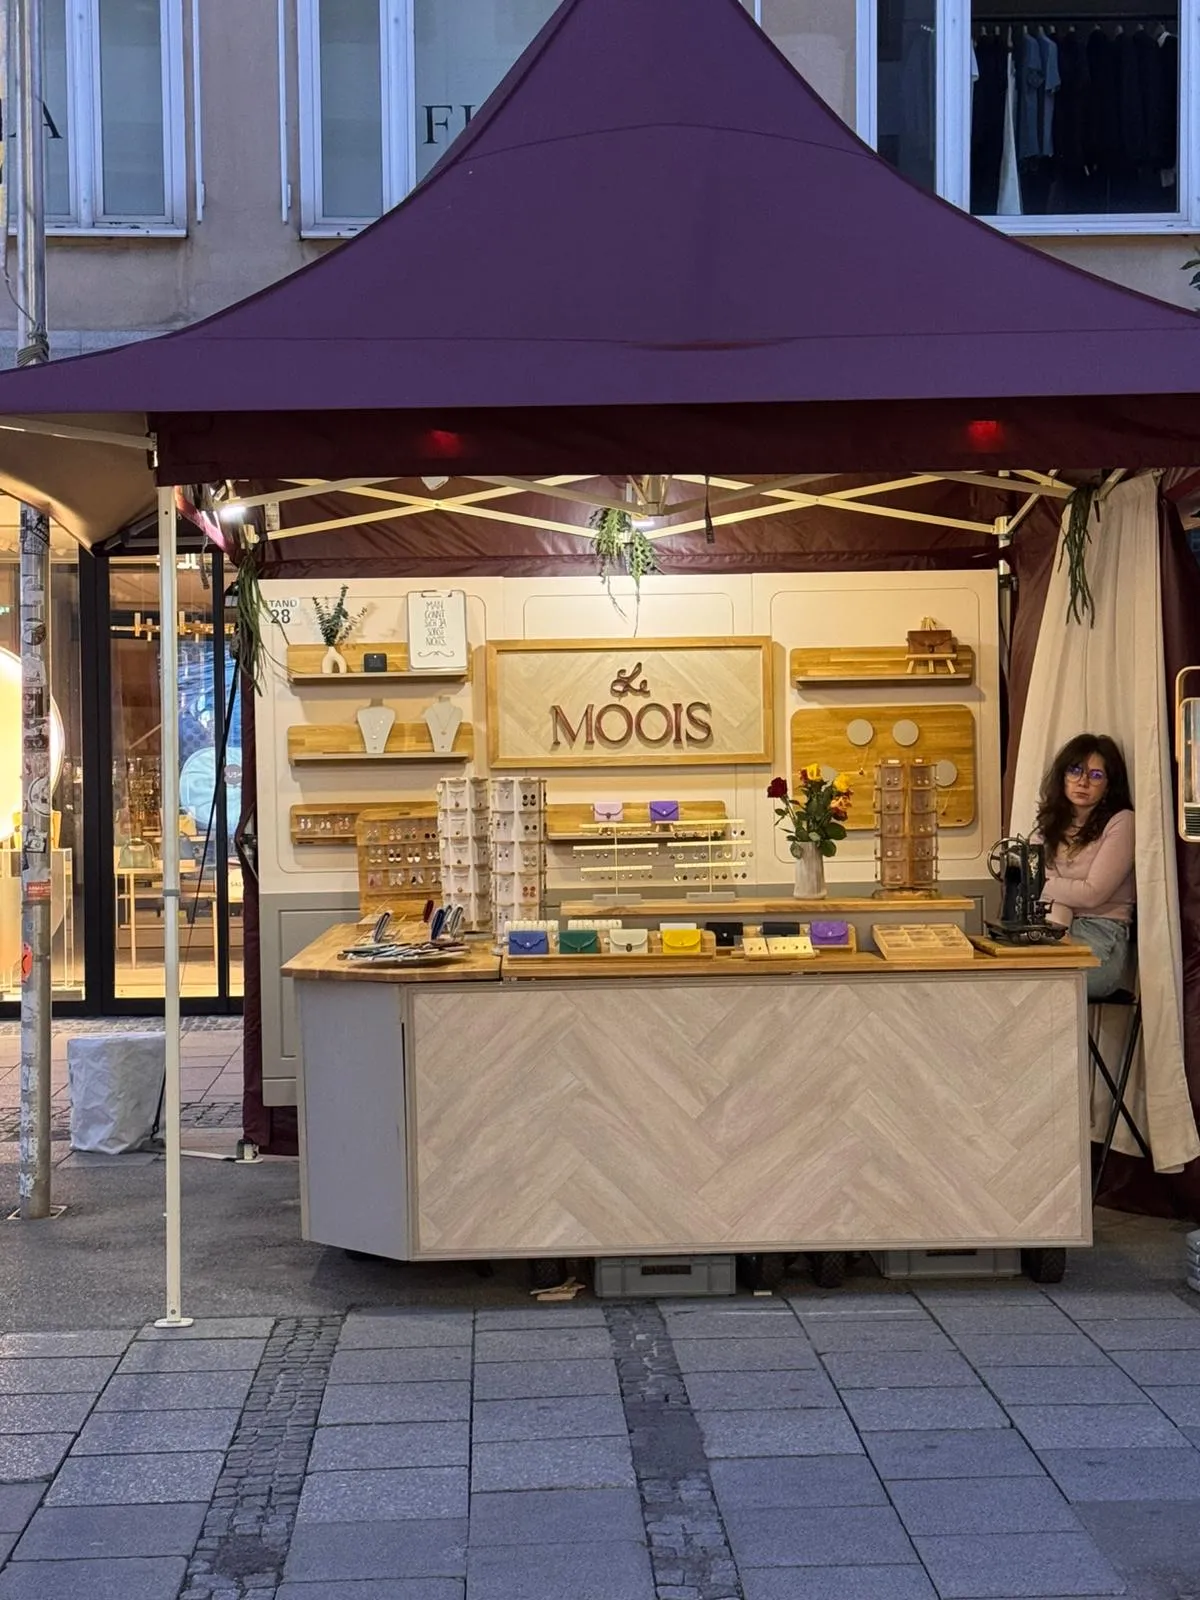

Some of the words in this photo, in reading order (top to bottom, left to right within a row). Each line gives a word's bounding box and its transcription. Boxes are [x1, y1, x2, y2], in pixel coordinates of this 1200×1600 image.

[264, 600, 298, 608] TAND
[270, 609, 290, 624] 28
[610, 661, 650, 697] Le
[551, 701, 713, 748] MOOIS
